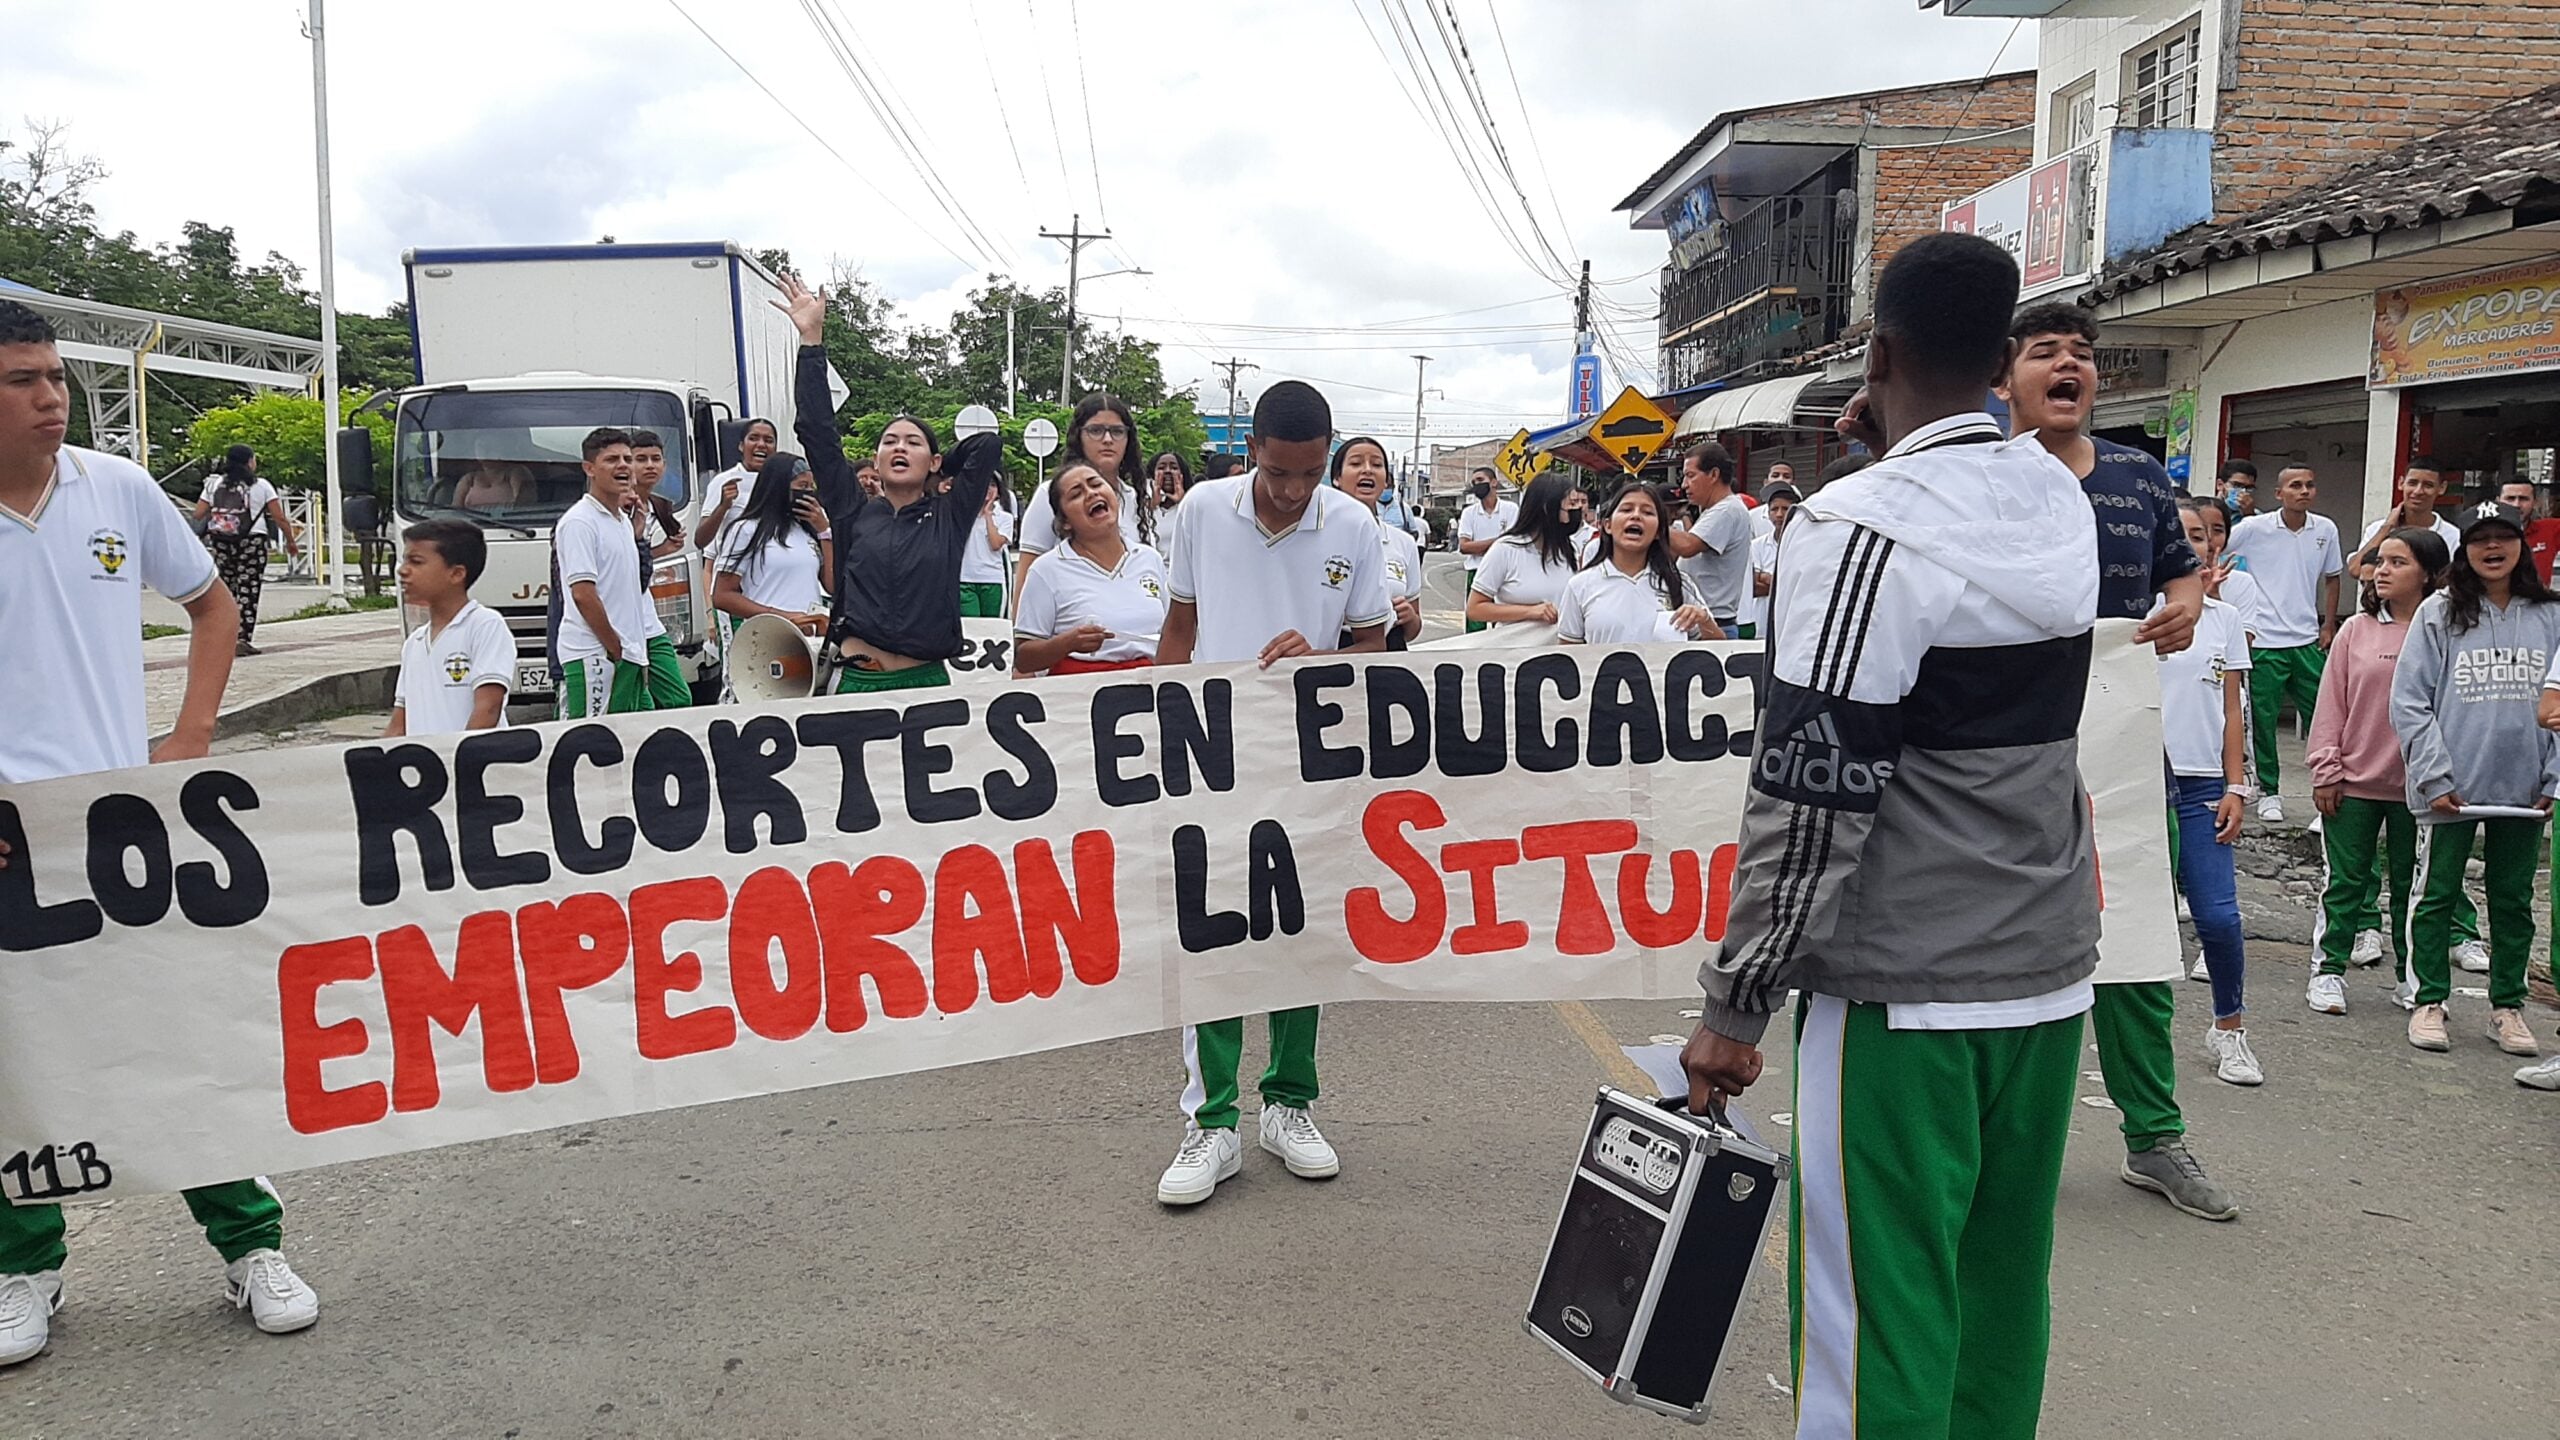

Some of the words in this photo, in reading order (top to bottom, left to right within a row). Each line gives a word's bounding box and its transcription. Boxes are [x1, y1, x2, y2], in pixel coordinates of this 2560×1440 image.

[2407, 287, 2560, 346] EXPOPA
[2443, 319, 2554, 348] MERCADERES
[2488, 350, 2511, 361] Pan
[2514, 347, 2530, 358] de
[512, 584, 551, 600] JA
[2454, 647, 2547, 668] ADIDAS
[520, 670, 548, 687] ESZ
[1761, 740, 1895, 794] didas
[0, 771, 270, 952] LOS
[345, 691, 1058, 906] RECORTES
[1091, 679, 1235, 807] EN
[1294, 650, 1765, 783] EDUCACI
[279, 830, 1120, 1134] EMPEORAN
[1172, 819, 1305, 953] LA
[1345, 790, 1738, 964] SITU
